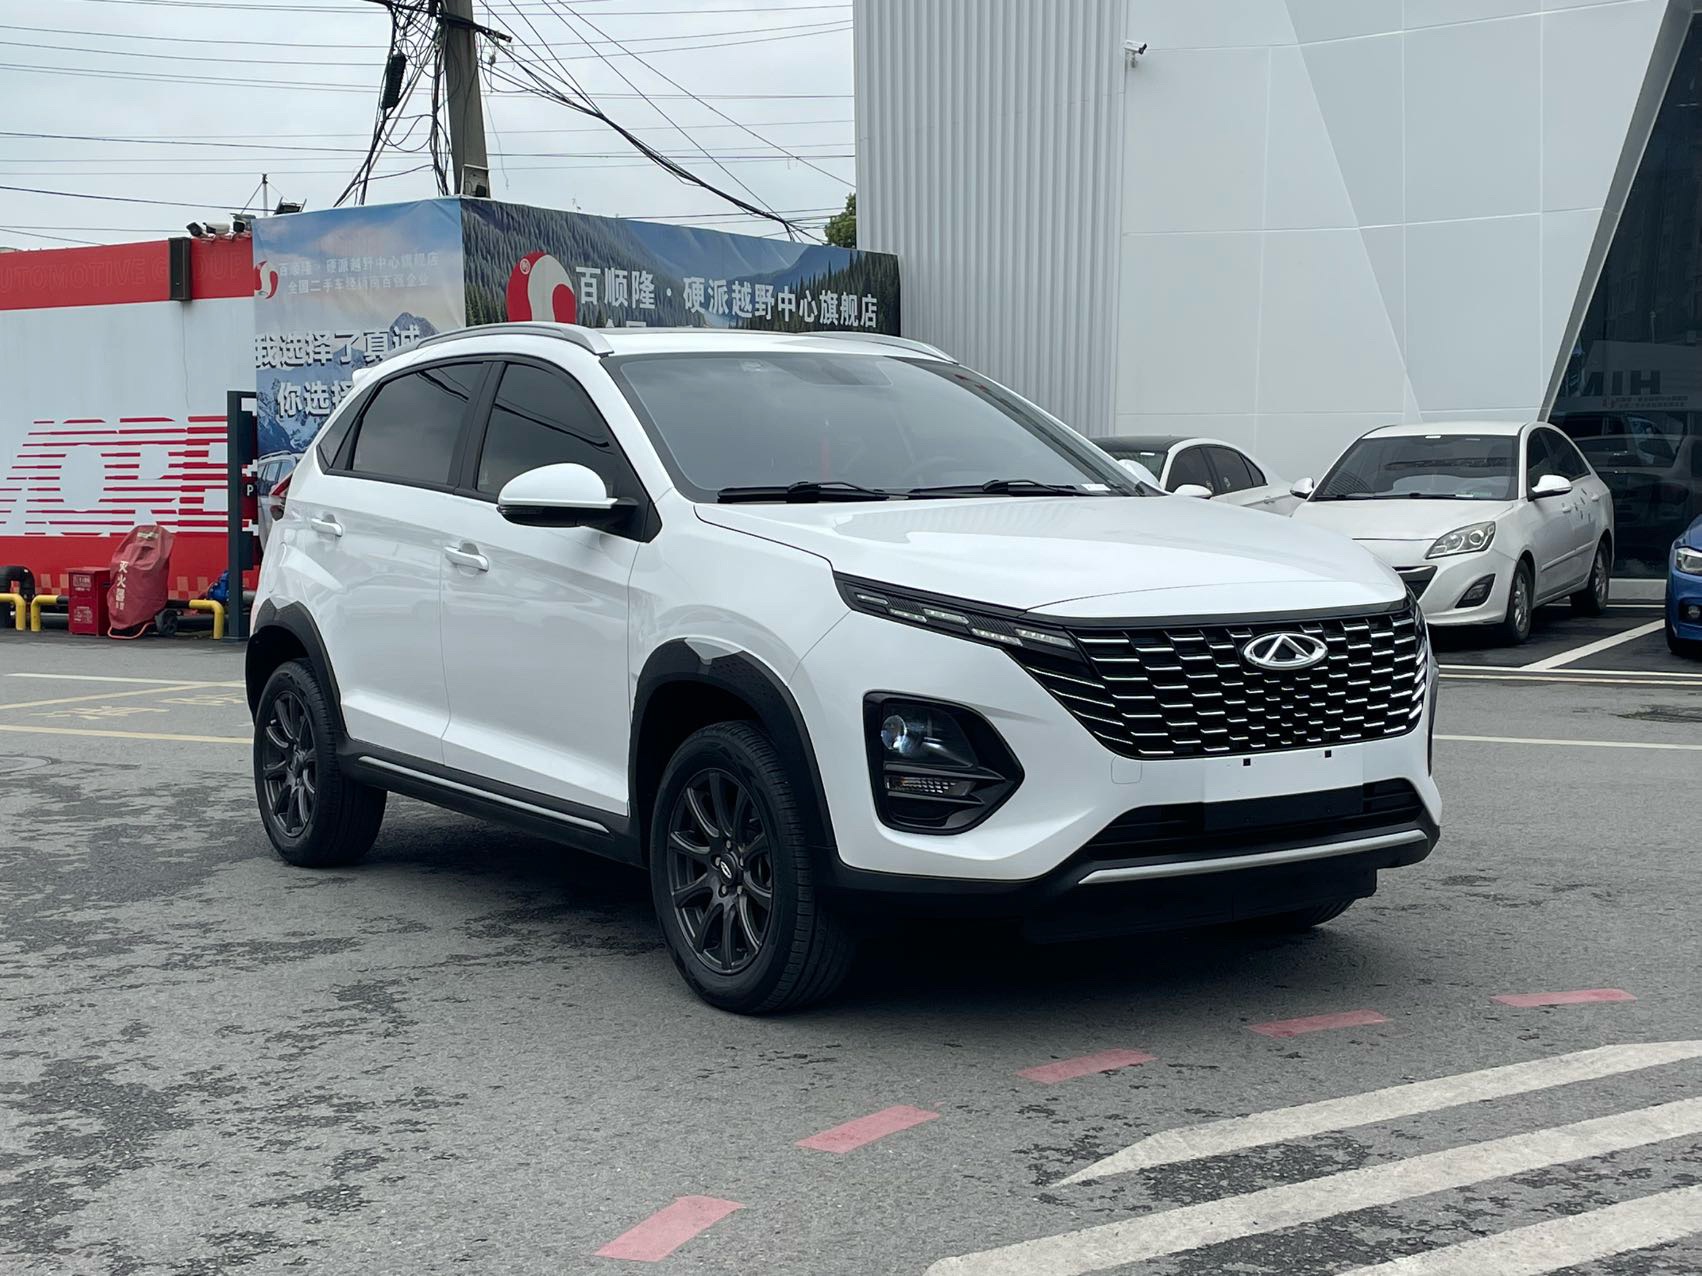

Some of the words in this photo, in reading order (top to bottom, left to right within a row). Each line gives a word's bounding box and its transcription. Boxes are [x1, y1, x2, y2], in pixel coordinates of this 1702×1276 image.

[575, 266, 878, 328] 百顺隆·硬派越野中心旗舰店
